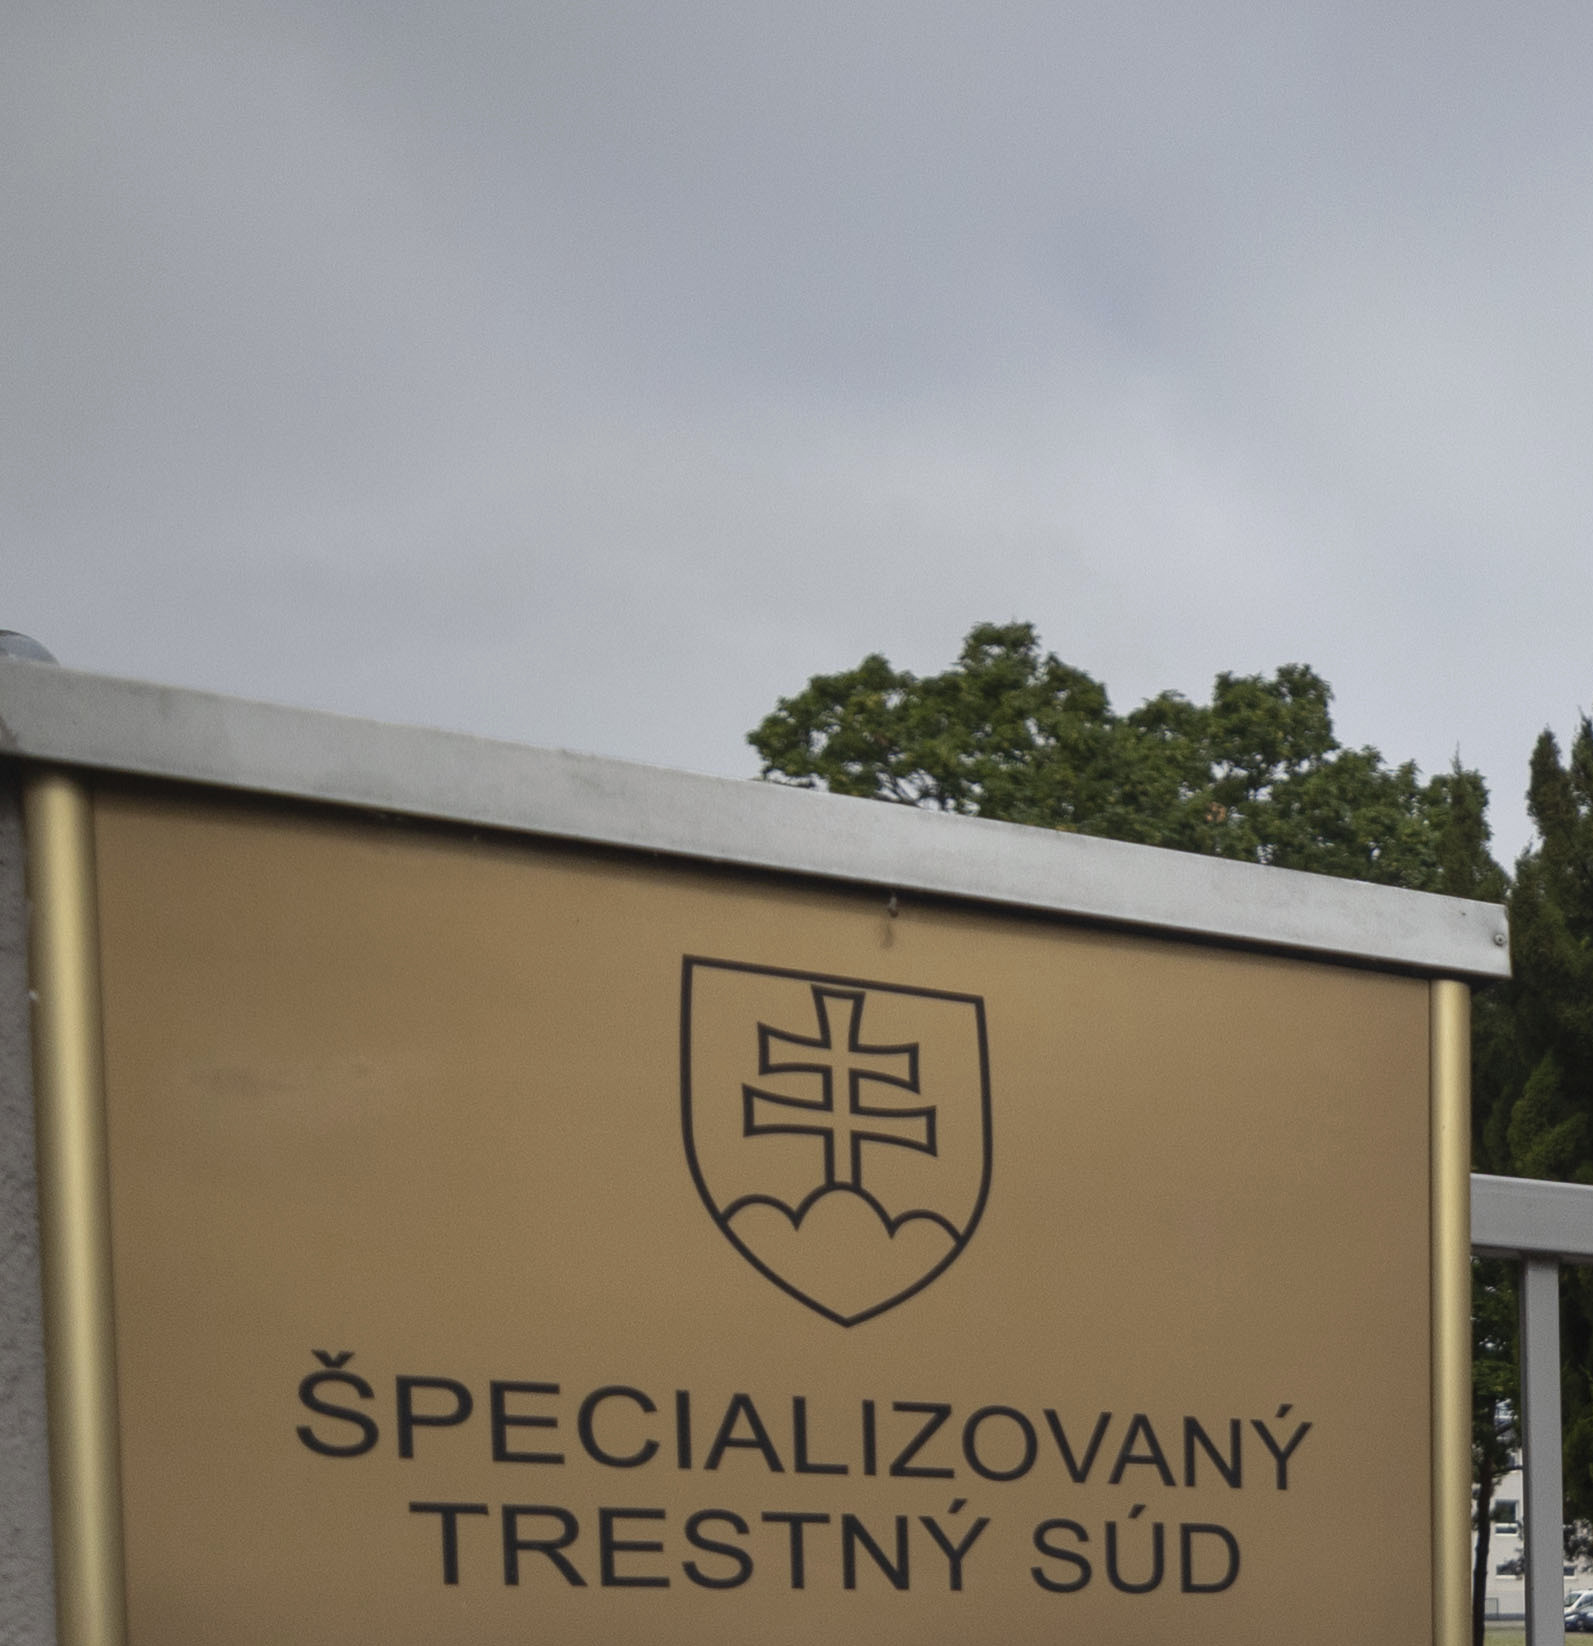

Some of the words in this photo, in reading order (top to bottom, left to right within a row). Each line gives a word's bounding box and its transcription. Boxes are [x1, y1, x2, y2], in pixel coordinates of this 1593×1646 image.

[294, 1349, 1314, 1491] ŠPECIALIZOVANÝ
[408, 1499, 991, 1591] TRESTNÝ
[1029, 1504, 1242, 1596] SÚD
